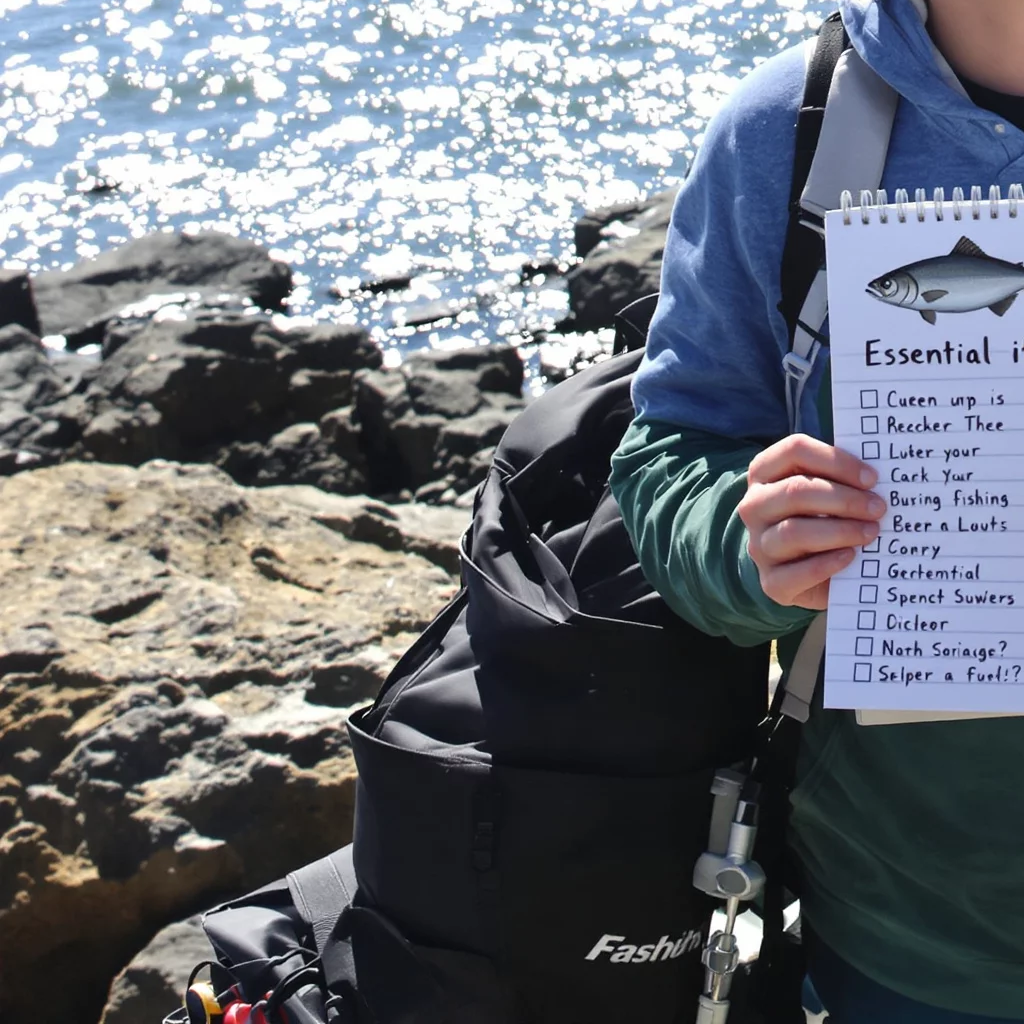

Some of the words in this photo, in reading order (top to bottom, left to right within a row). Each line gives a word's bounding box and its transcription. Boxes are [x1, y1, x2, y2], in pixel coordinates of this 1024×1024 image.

[865, 336, 991, 366] Essential
[991, 389, 1004, 405] is
[944, 447, 980, 462] your
[891, 467, 928, 482] Cark
[954, 489, 1008, 507] fishing
[893, 515, 932, 533] Beer
[945, 672, 953, 680] a
